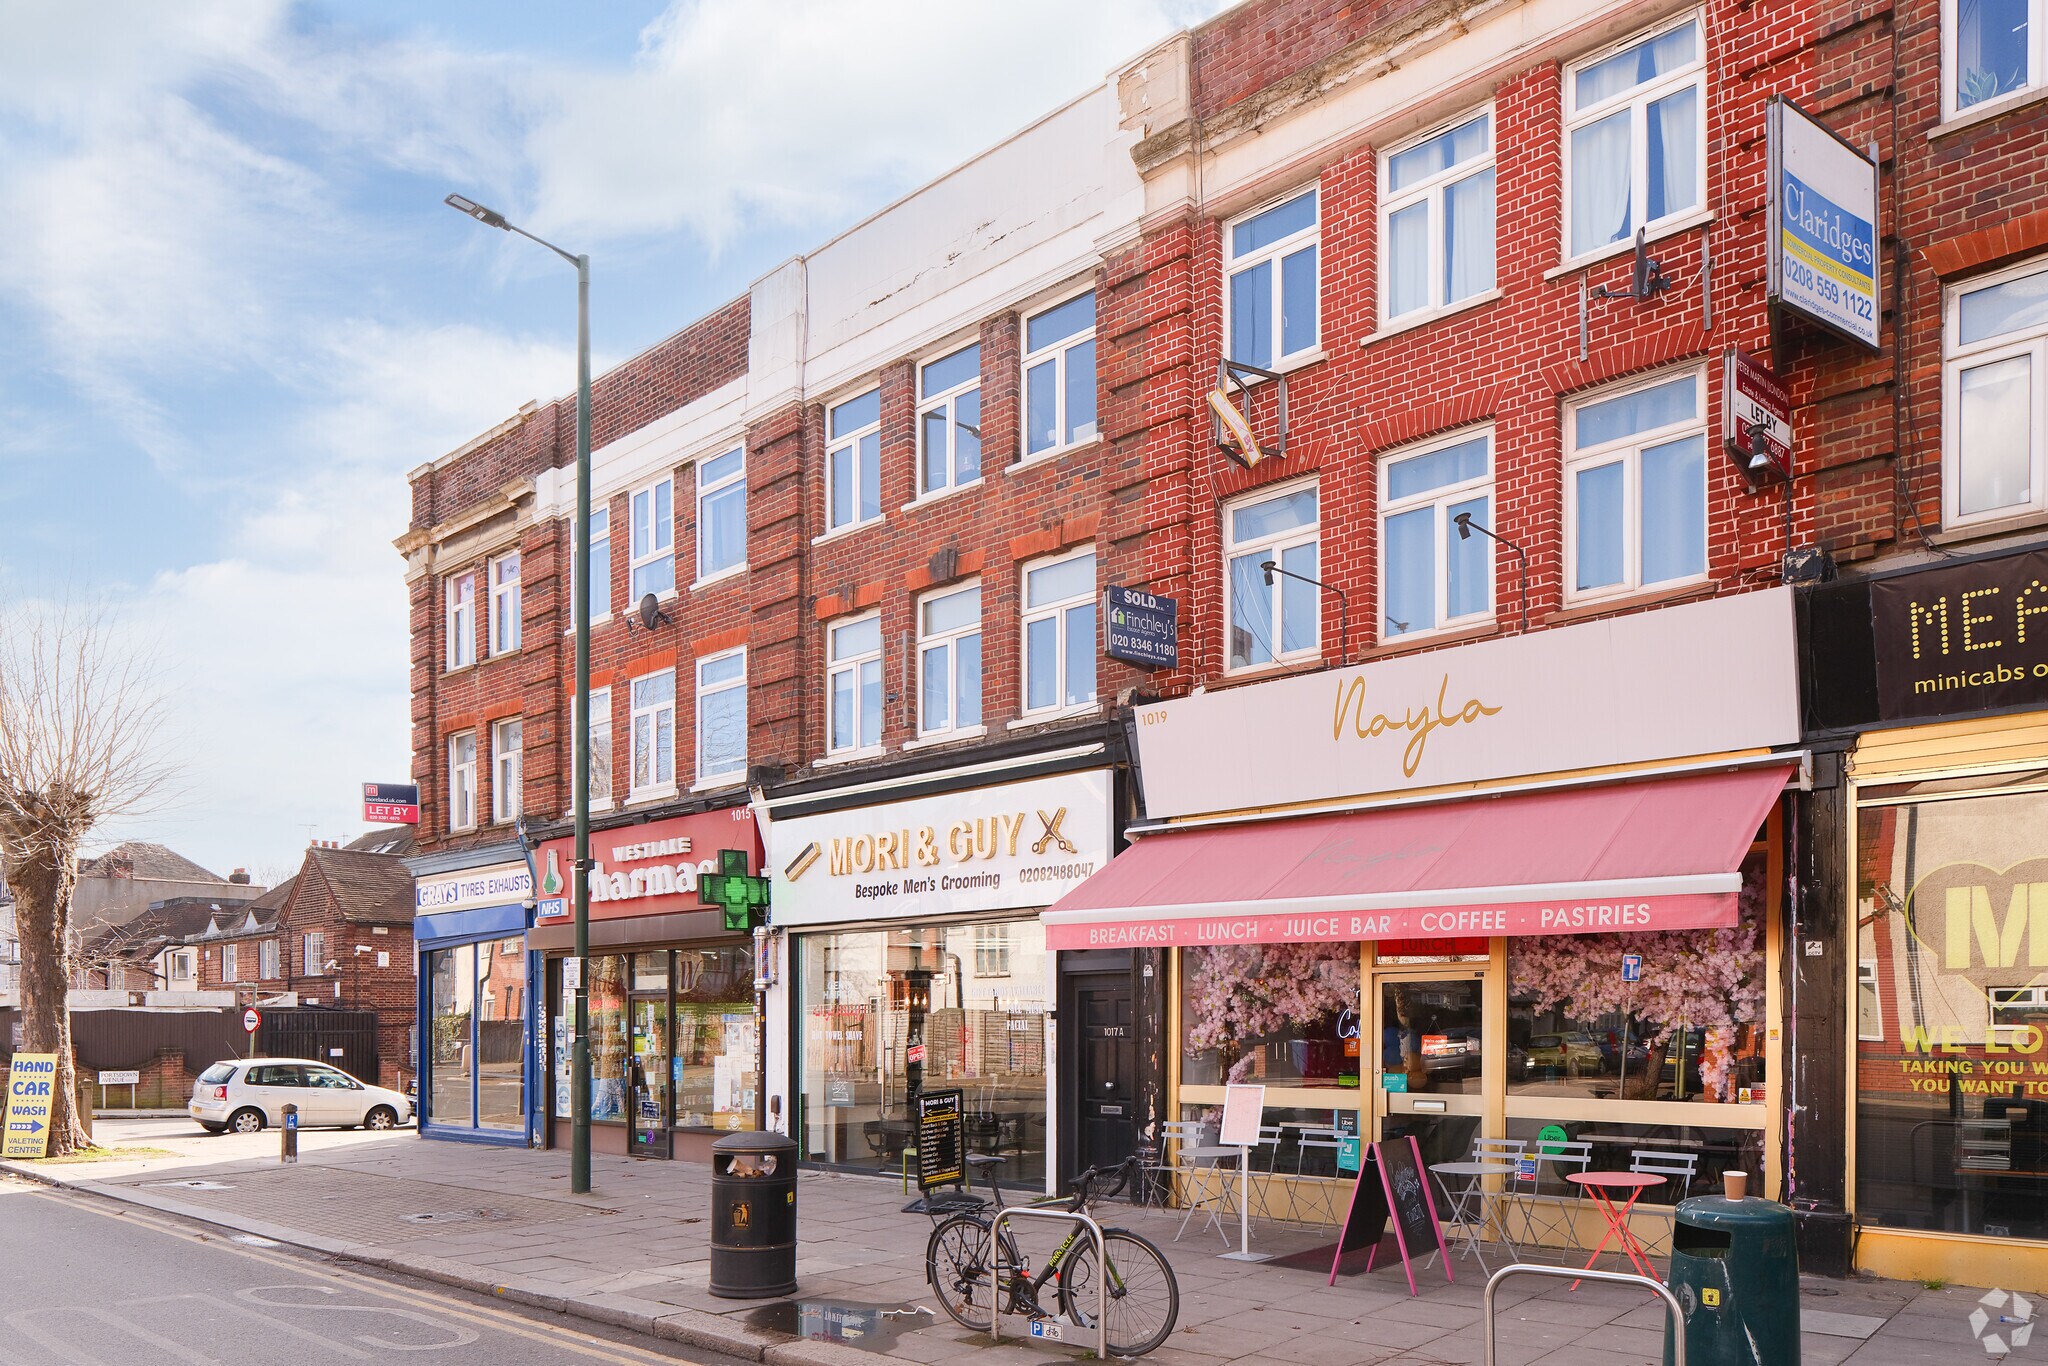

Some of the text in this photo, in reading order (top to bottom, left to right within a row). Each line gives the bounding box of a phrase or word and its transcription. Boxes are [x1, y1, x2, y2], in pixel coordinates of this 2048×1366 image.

[1785, 183, 1872, 265] Claridges
[1786, 237, 1871, 291] COMMERCIAL PROPERTY CONSULTANTS
[1785, 255, 1872, 321] 0208 559 1122
[1737, 359, 1750, 377] PETER
[1750, 370, 1767, 389] MARTIN
[1742, 382, 1755, 398] Estate
[1755, 393, 1759, 401] &
[1750, 403, 1777, 434] LET BY
[1124, 590, 1156, 608] SOLD
[1126, 611, 1174, 640] Finchley's
[1112, 634, 1175, 656] 020 8346 1180
[1914, 664, 2025, 694] minicabs
[1142, 711, 1168, 726] 1019
[1333, 673, 1503, 778] Nayla
[369, 805, 408, 816] LET BY
[731, 808, 751, 822] 1015
[612, 837, 692, 862] WESTLAKE
[828, 812, 1025, 876] MORI & GUY
[1019, 862, 1094, 884] 02082488047
[419, 874, 530, 907] GRAYS TYRES EXHAUSTS
[855, 871, 1001, 900] Bespoke Men's Grooming
[541, 901, 560, 914] NHS
[1089, 903, 1651, 945] BREAKFAST LUNCH JUICE BAR COFFEE PASTRIES
[826, 1030, 843, 1040] TOWEL
[846, 1030, 863, 1040] SHAVE
[1006, 1020, 1029, 1030] FACIAL
[1901, 1024, 2048, 1054] WE LO
[13, 1061, 54, 1073] HAND
[908, 1052, 925, 1062] OPEN
[1899, 1060, 1973, 1074] TAKING
[1980, 1061, 2024, 1075] YOU
[12, 1081, 50, 1096] CAR
[1909, 1079, 1951, 1092] YOU
[1957, 1080, 2018, 1094] WANT
[12, 1106, 46, 1116] WASH
[1033, 1323, 1040, 1334] P
